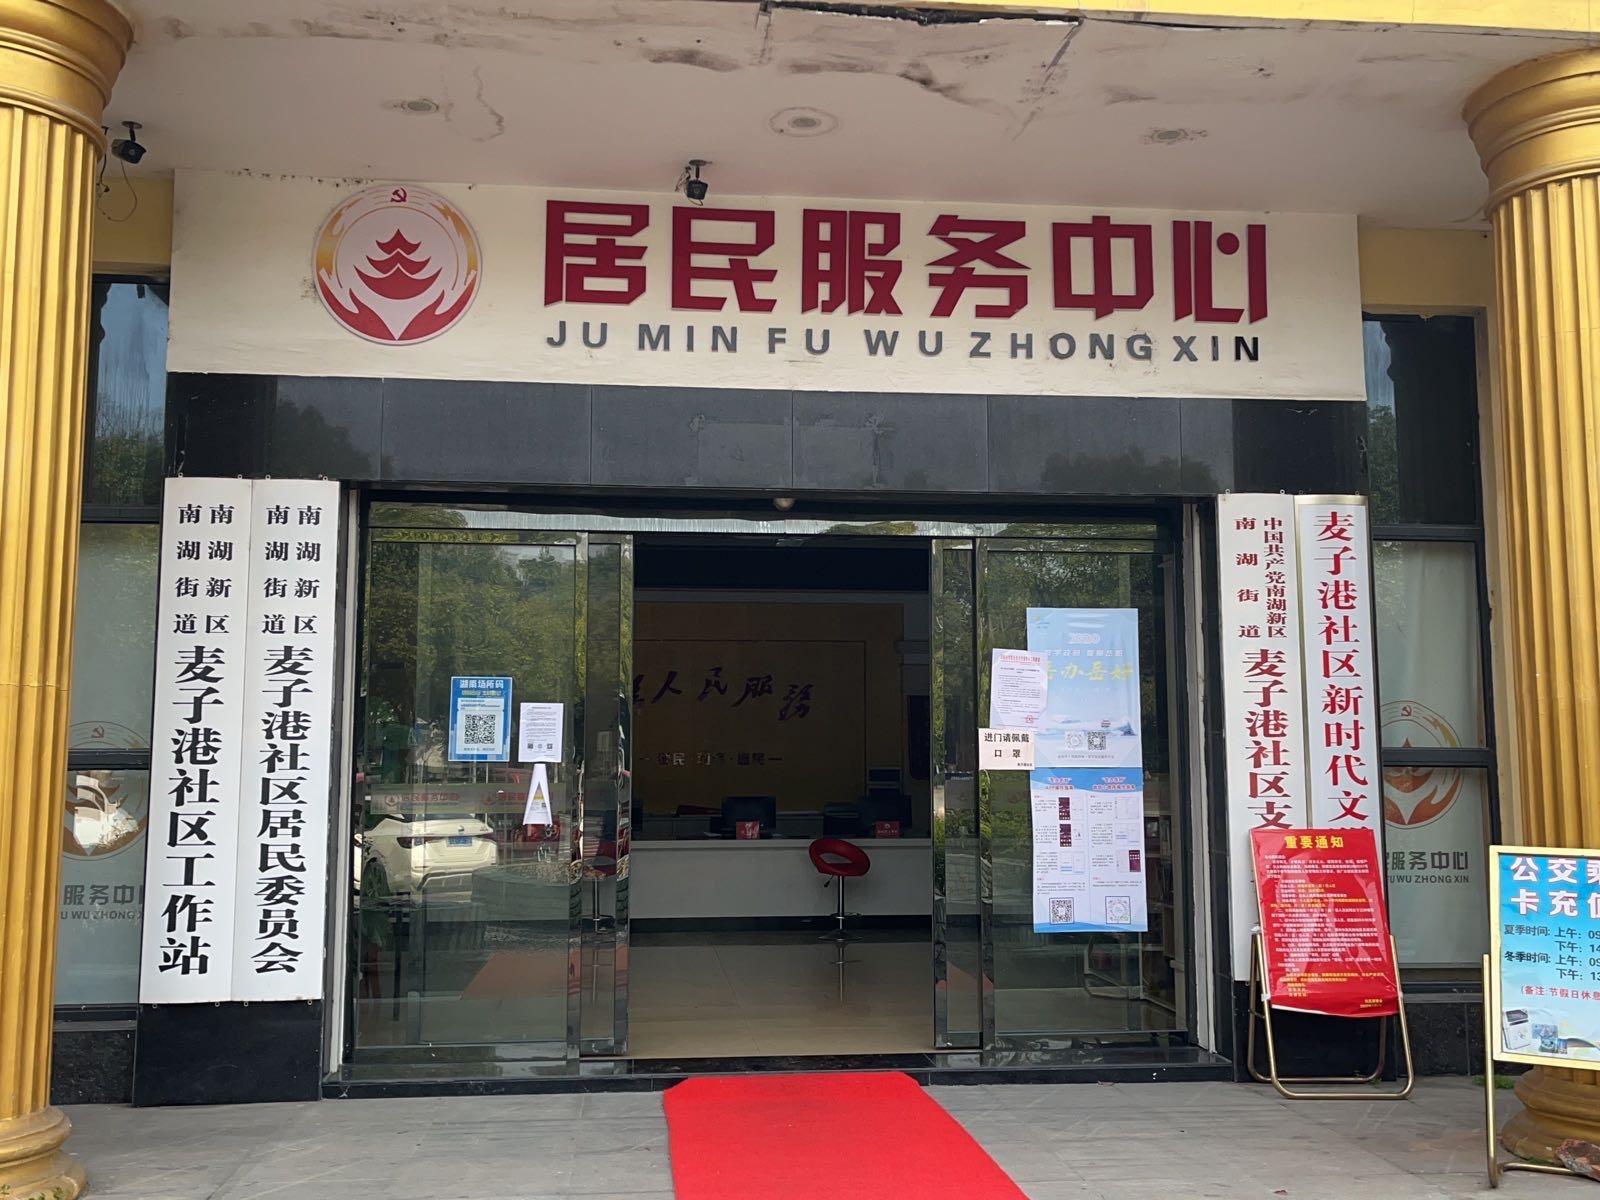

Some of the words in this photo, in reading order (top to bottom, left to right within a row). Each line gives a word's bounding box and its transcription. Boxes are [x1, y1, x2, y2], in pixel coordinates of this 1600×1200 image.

[544, 199, 1268, 324] 居民服务中心
[546, 320, 608, 348] JU
[638, 323, 738, 353] MIN
[768, 327, 830, 355] FU
[864, 329, 944, 357] WU
[969, 331, 1153, 361] ZHONG
[1173, 335, 1260, 362] XIN
[173, 503, 203, 635] 南湖街道
[205, 503, 235, 635] 南湖新区
[261, 505, 291, 635] 南湖街道
[293, 505, 323, 635] 南湖新区
[1234, 516, 1262, 639] 南湖街道
[1263, 517, 1288, 638] 中国共产党南湖新区
[1314, 511, 1370, 830] 麦子港社区新时代文
[984, 733, 1030, 743] 进门请佩戴
[1242, 648, 1294, 829] 麦子港社区支
[158, 645, 226, 976] 麦子港社区工作站
[250, 645, 314, 974] 麦子港社区居民委员会
[1284, 835, 1344, 849] 重要通知
[1387, 851, 1469, 870] 服务中心
[64, 884, 143, 906] 服务中
[1396, 875, 1412, 883] WU
[1415, 875, 1452, 884] ZHONG
[1454, 875, 1469, 883] XIN
